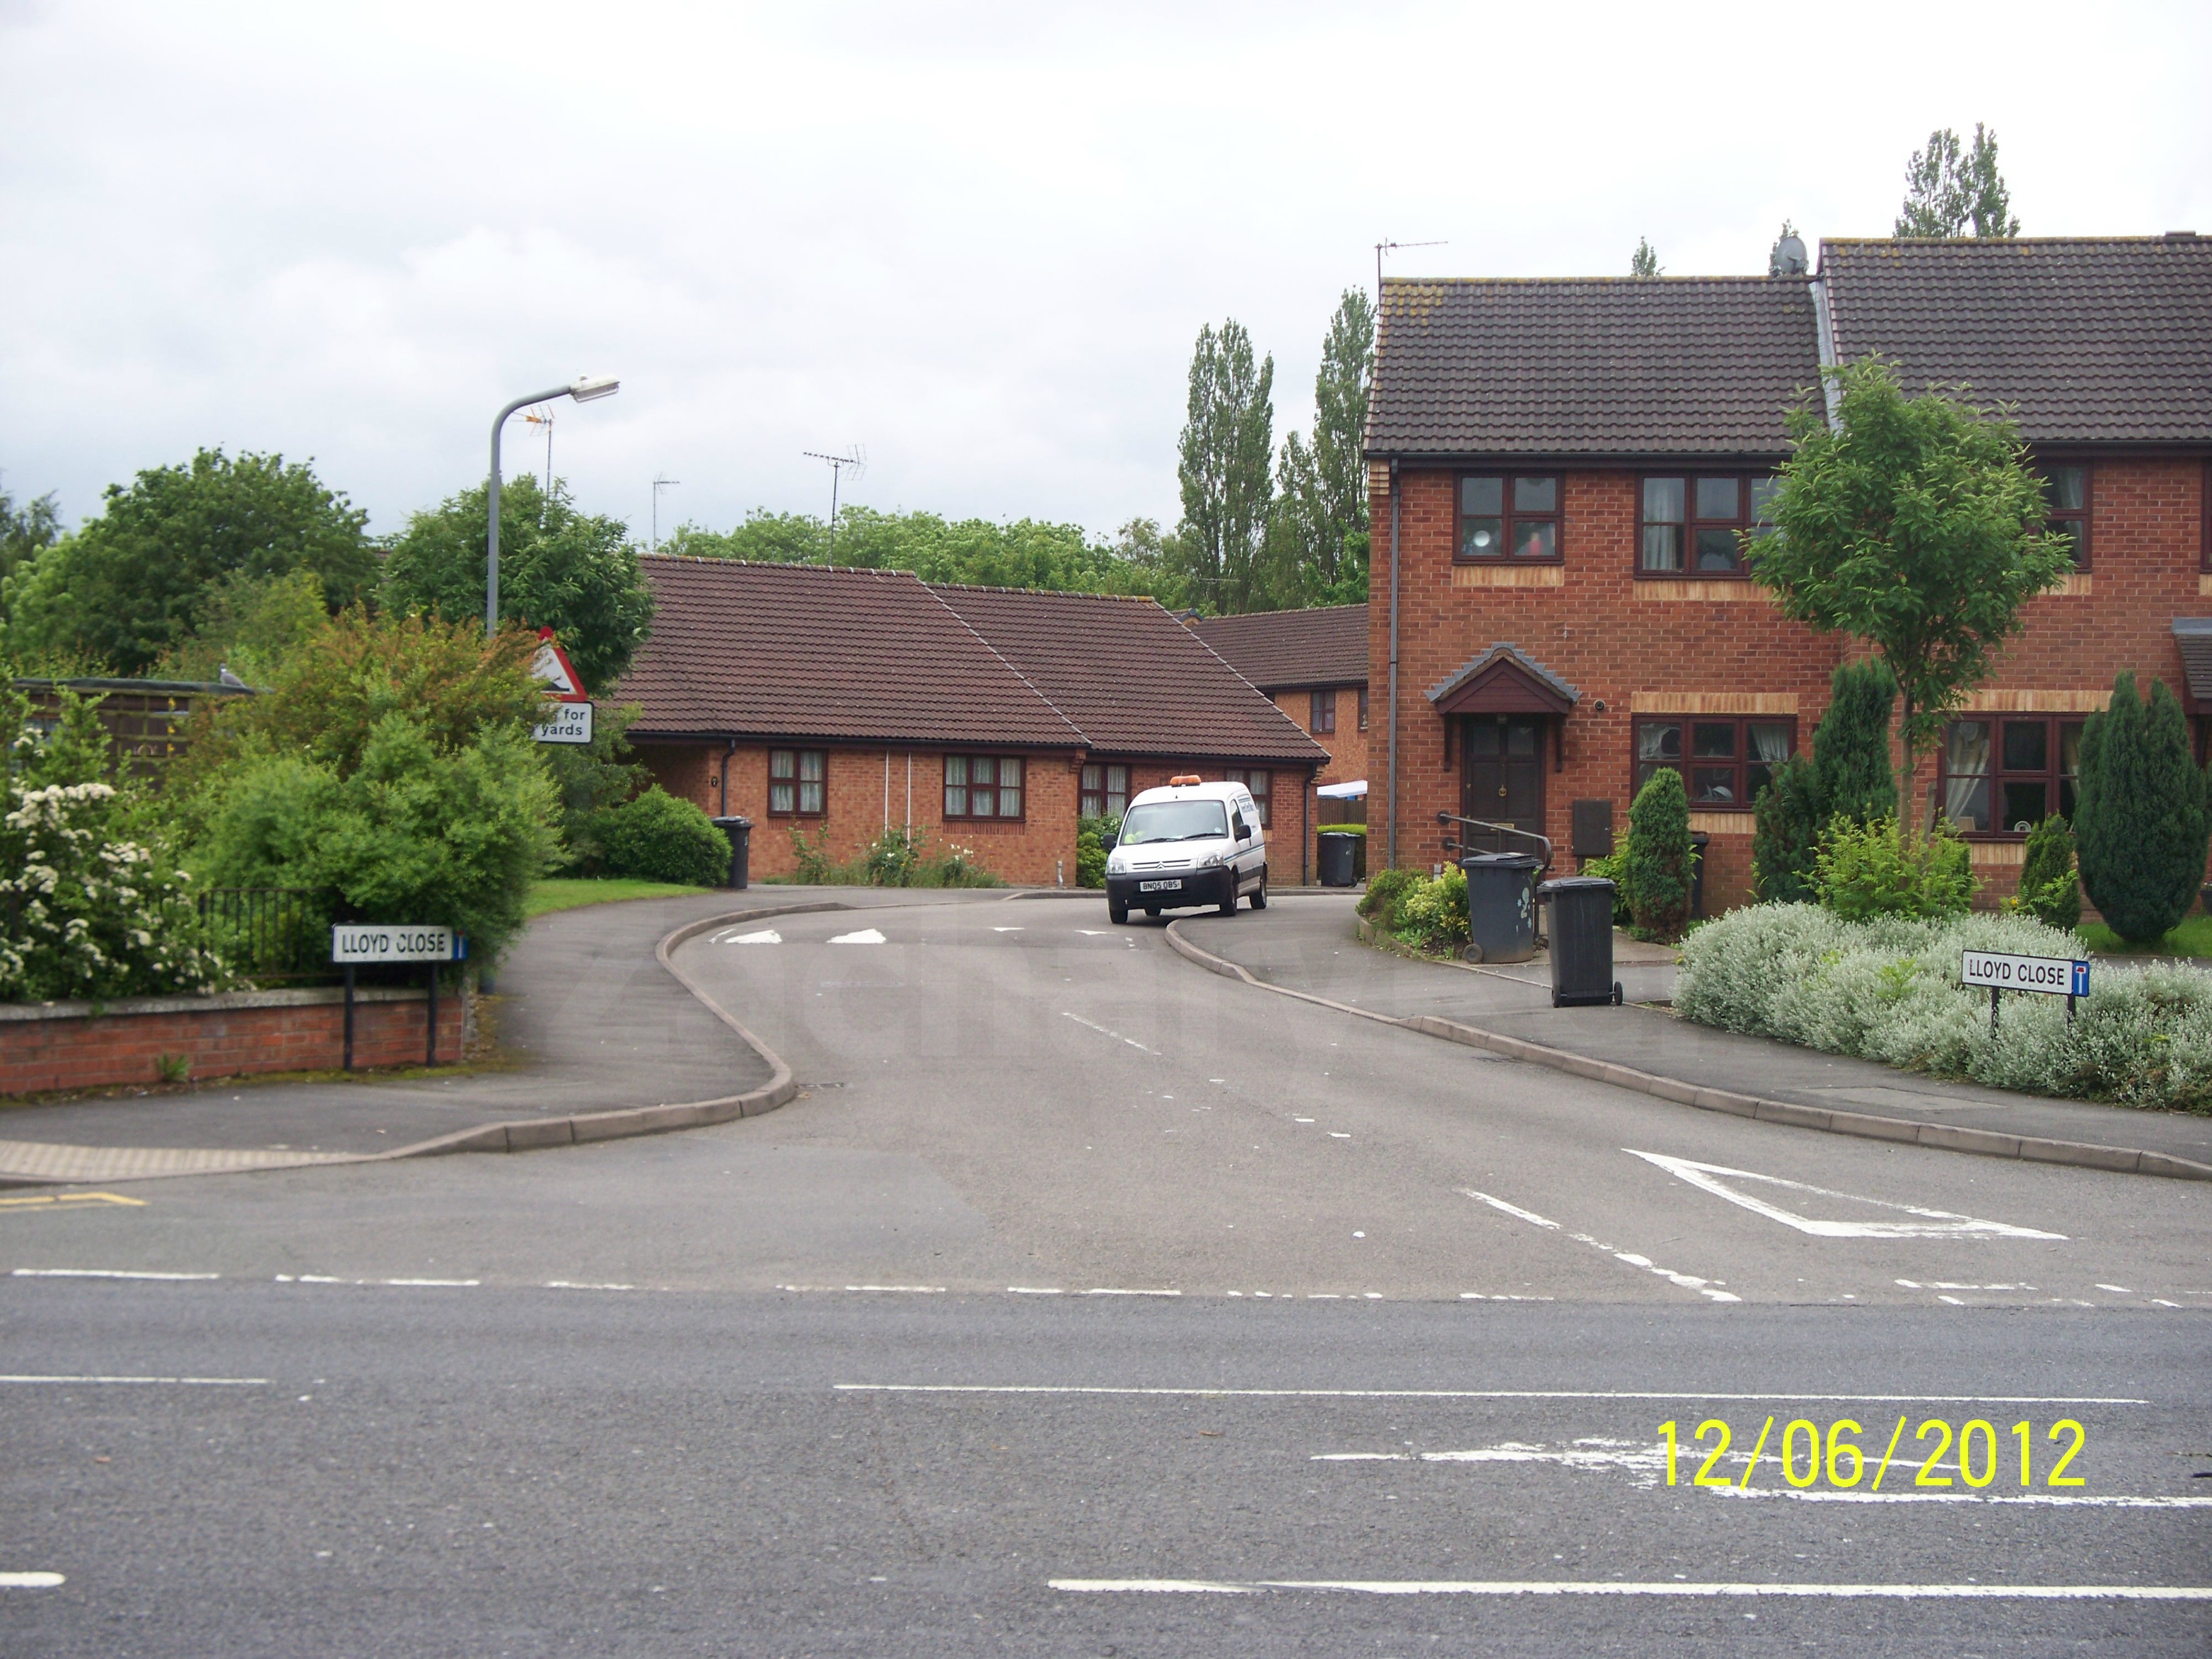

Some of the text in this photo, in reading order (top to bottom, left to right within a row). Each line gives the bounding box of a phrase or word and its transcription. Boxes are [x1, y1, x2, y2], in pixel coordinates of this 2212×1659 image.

[564, 709, 586, 721] for
[542, 724, 583, 736] yards
[1143, 882, 1162, 890] BN05
[342, 933, 446, 953] LLOYD CLOSE
[1969, 960, 2065, 986] LLOYD CLOSE
